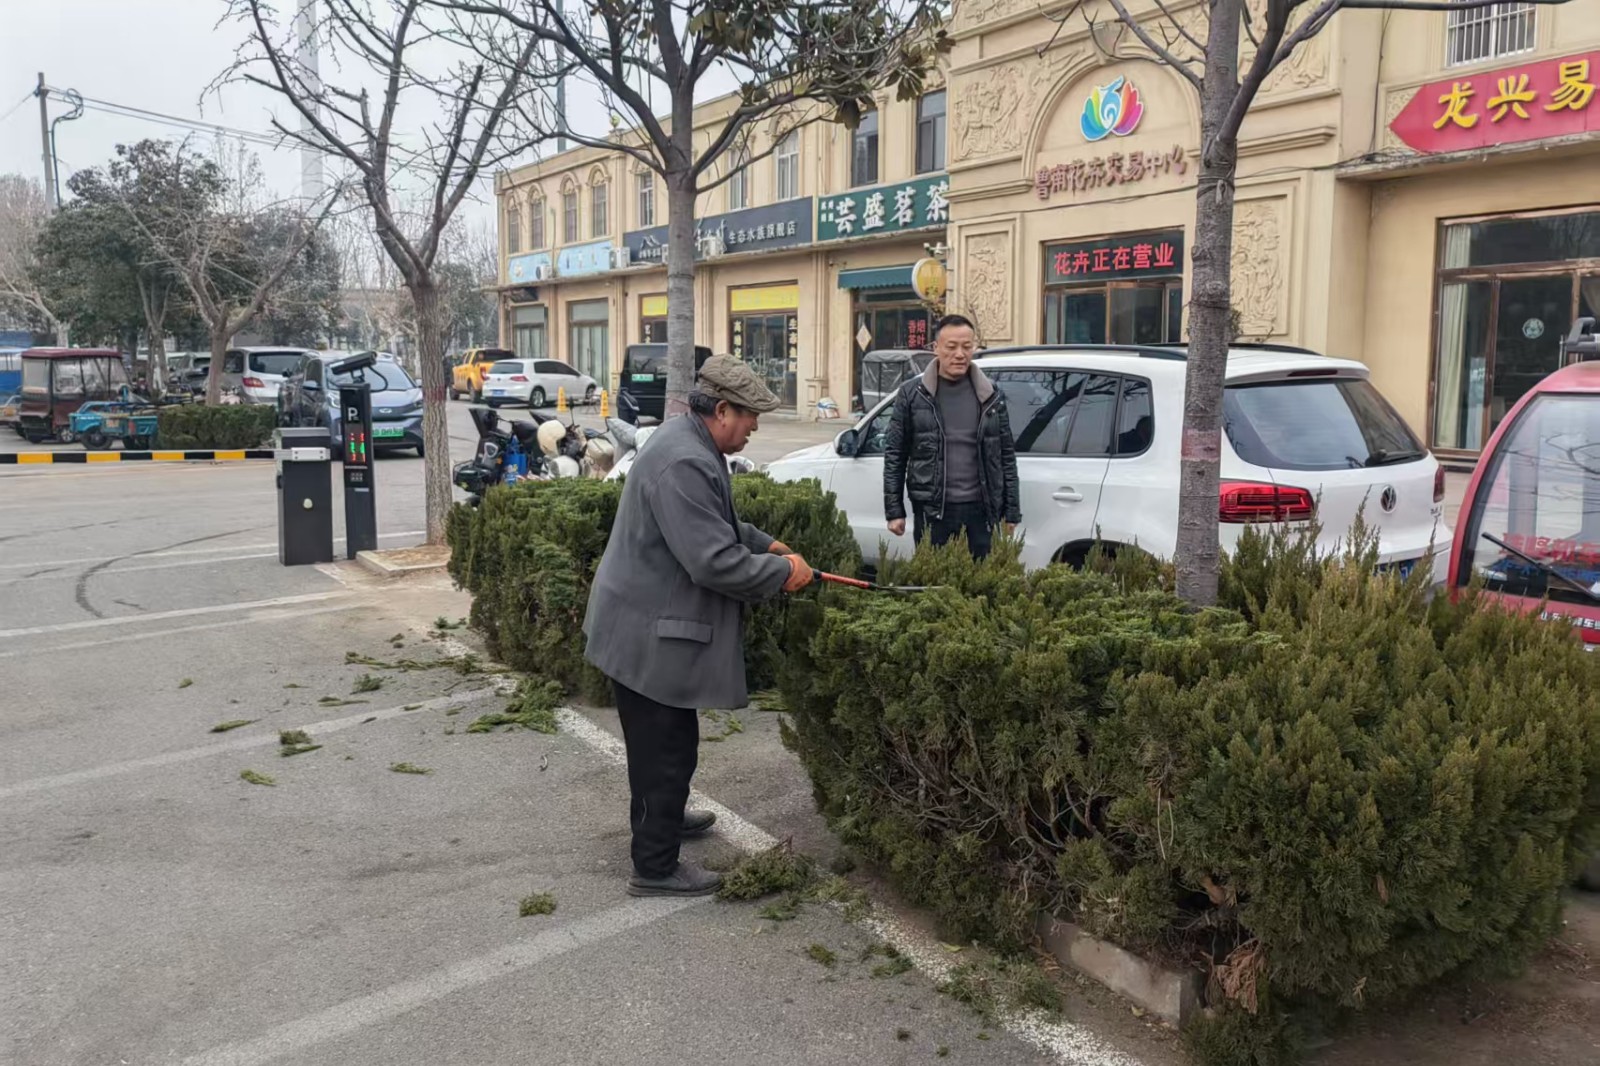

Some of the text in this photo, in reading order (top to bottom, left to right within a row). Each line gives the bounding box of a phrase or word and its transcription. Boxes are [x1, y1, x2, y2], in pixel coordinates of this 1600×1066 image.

[1432, 59, 1596, 129] 龙兴易
[1034, 144, 1188, 200] 鲁南花卉交易中心
[729, 221, 797, 243] 生态水族旗舰店
[1054, 243, 1174, 276] 花卉正在营业
[907, 319, 926, 333] 香烟
[907, 334, 926, 348] 茶叶
[347, 407, 359, 421] P
